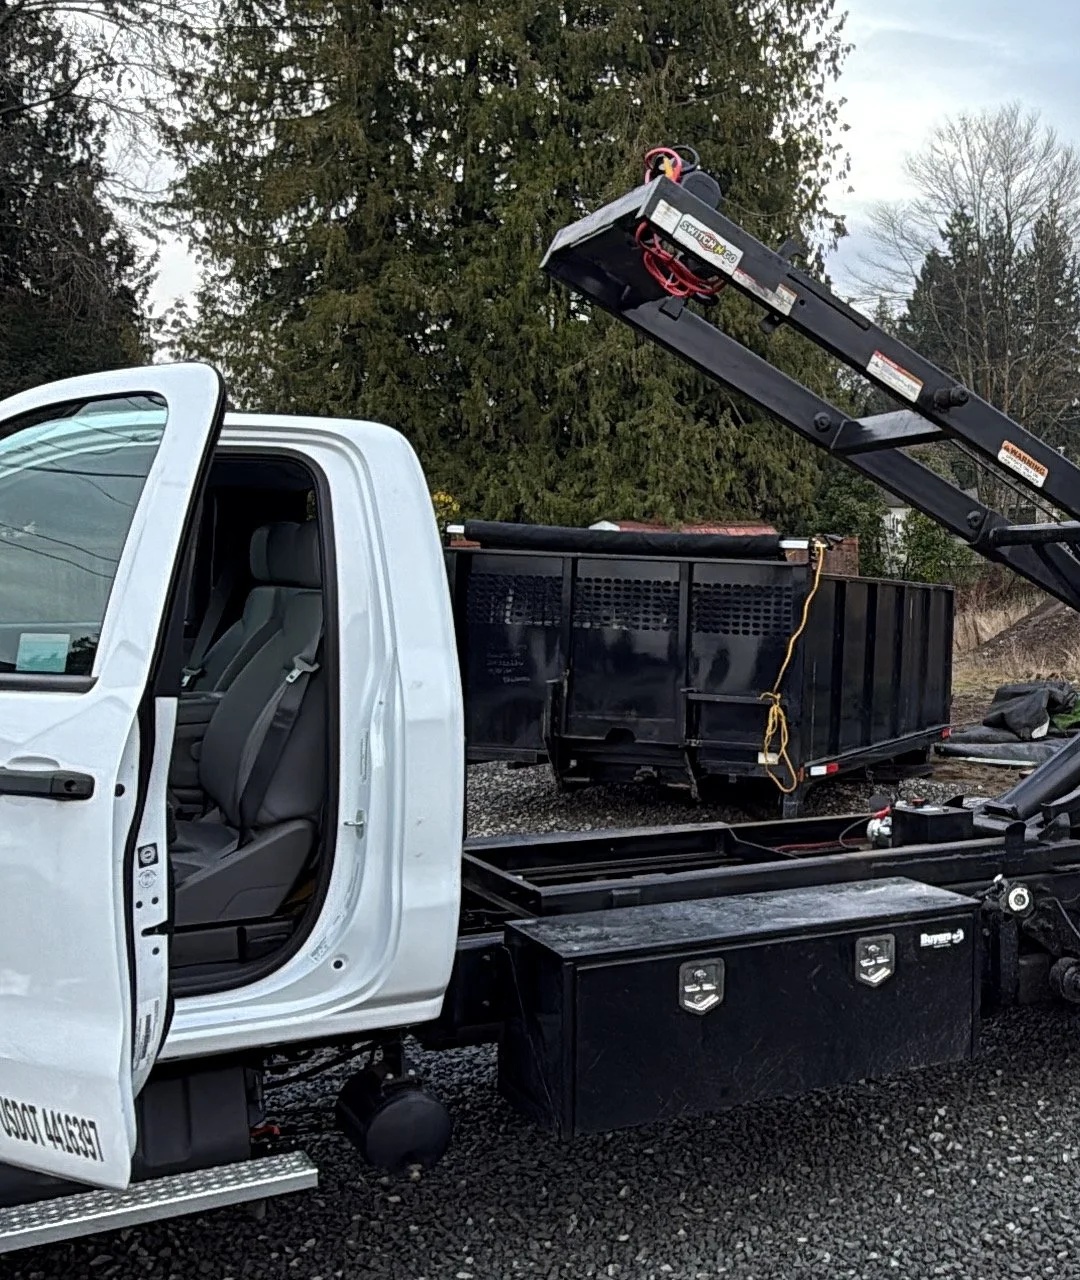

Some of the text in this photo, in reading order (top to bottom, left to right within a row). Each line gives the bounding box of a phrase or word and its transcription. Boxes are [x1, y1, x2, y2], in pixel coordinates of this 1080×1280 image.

[680, 220, 717, 248] SWITCH
[1010, 447, 1046, 476] WARNING
[0, 1096, 104, 1162] USDOT 4416397
